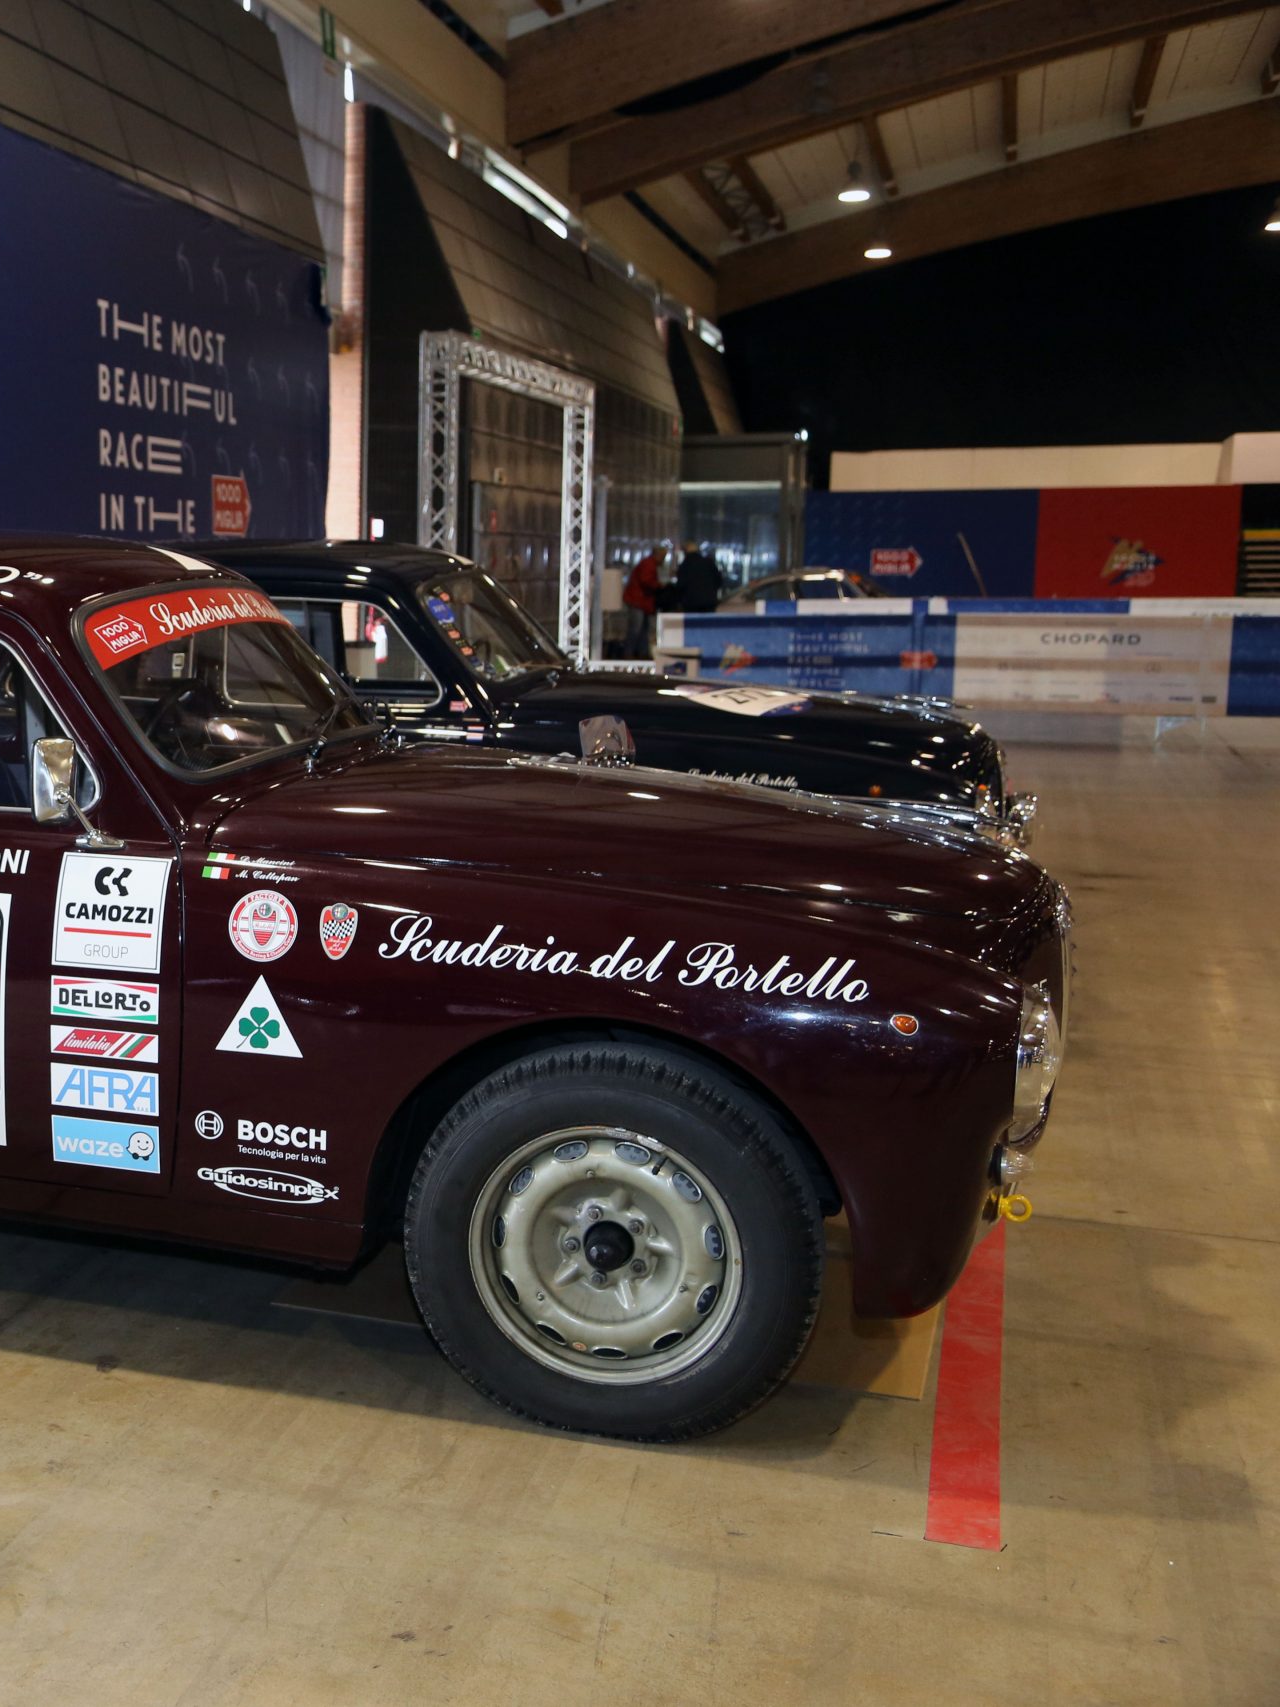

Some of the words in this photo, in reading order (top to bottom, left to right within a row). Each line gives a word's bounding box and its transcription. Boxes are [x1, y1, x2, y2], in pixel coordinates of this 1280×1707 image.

[97, 299, 163, 351] THE
[171, 320, 225, 366] MOST
[98, 363, 237, 425] BEAUTIFUL
[99, 428, 183, 475] RACE
[216, 484, 242, 503] 1000
[100, 493, 124, 531] IN
[134, 496, 196, 534] THE
[215, 510, 244, 530] MIGLIA
[102, 621, 130, 638] 1000
[110, 631, 141, 650] MIGLIA
[1040, 633, 1142, 646] CHOPARD
[65, 902, 154, 924] CAMOZZI
[83, 943, 129, 959] GROUP
[378, 914, 580, 975] Scuderia
[588, 935, 676, 982] del
[678, 941, 870, 1003] Portello
[58, 987, 152, 1012] DELLORTO
[56, 1067, 157, 1113] AFRA
[57, 1135, 125, 1158] waze
[237, 1119, 327, 1151] BOSCH
[237, 1144, 284, 1159] Tecnologia
[285, 1152, 300, 1161] per
[301, 1153, 309, 1162] la
[310, 1155, 327, 1164] vita
